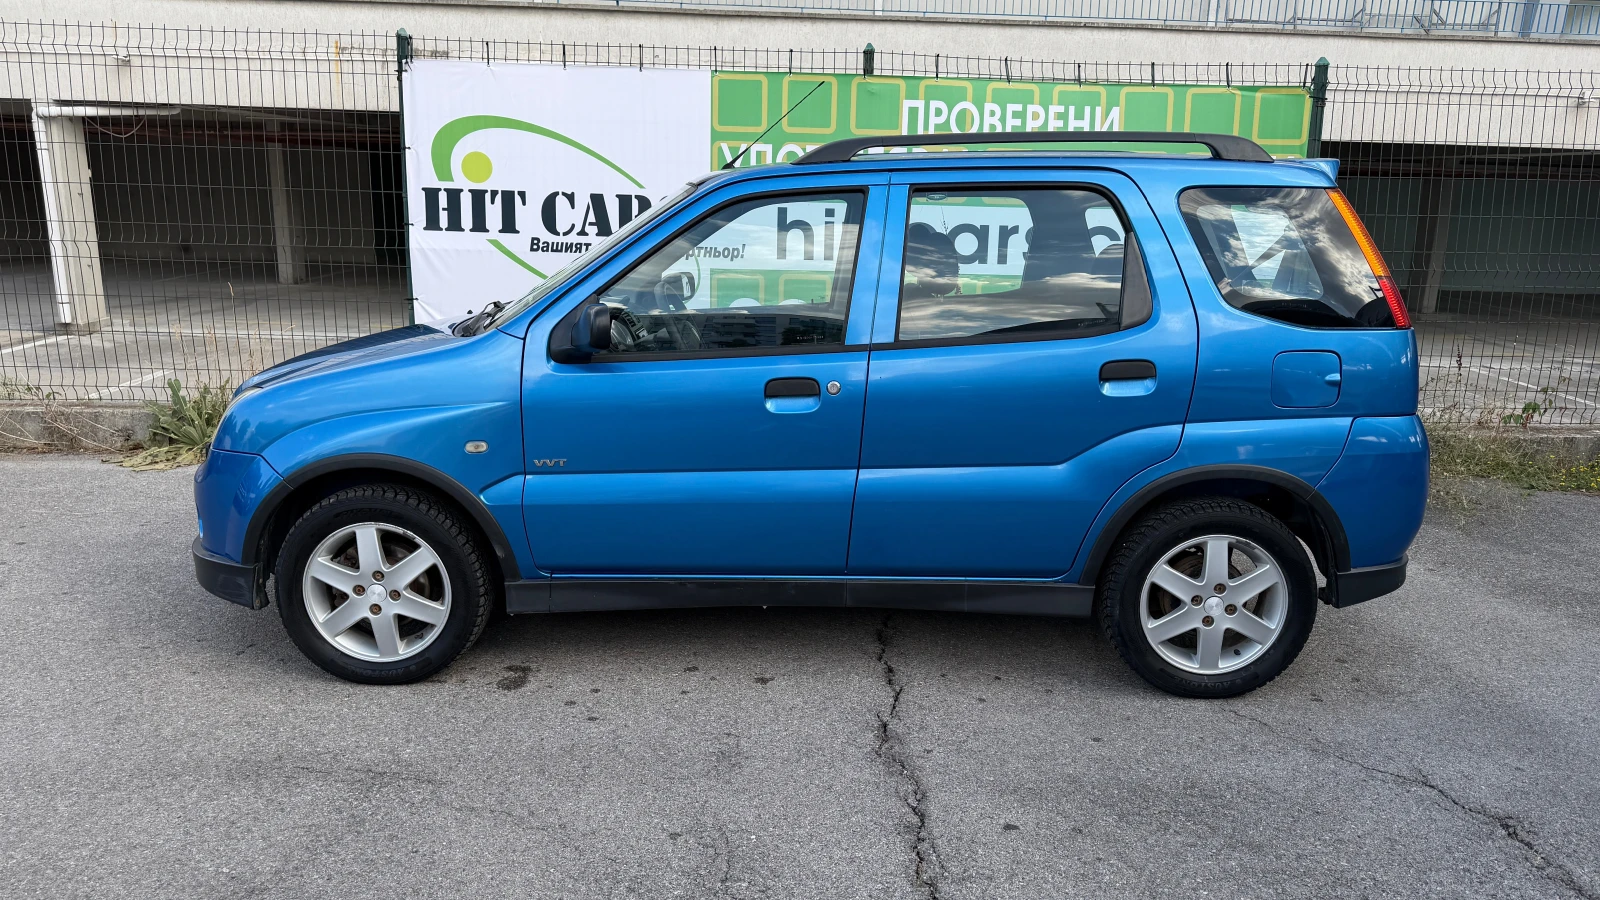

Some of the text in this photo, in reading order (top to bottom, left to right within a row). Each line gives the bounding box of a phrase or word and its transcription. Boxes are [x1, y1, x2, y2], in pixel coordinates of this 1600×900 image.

[901, 99, 1120, 135] ПРОВЕРЕНИ
[421, 186, 668, 237] HIT CAR
[530, 237, 746, 262] Вашият ртньор!
[776, 206, 845, 261] hi
[533, 458, 567, 467] VVT
